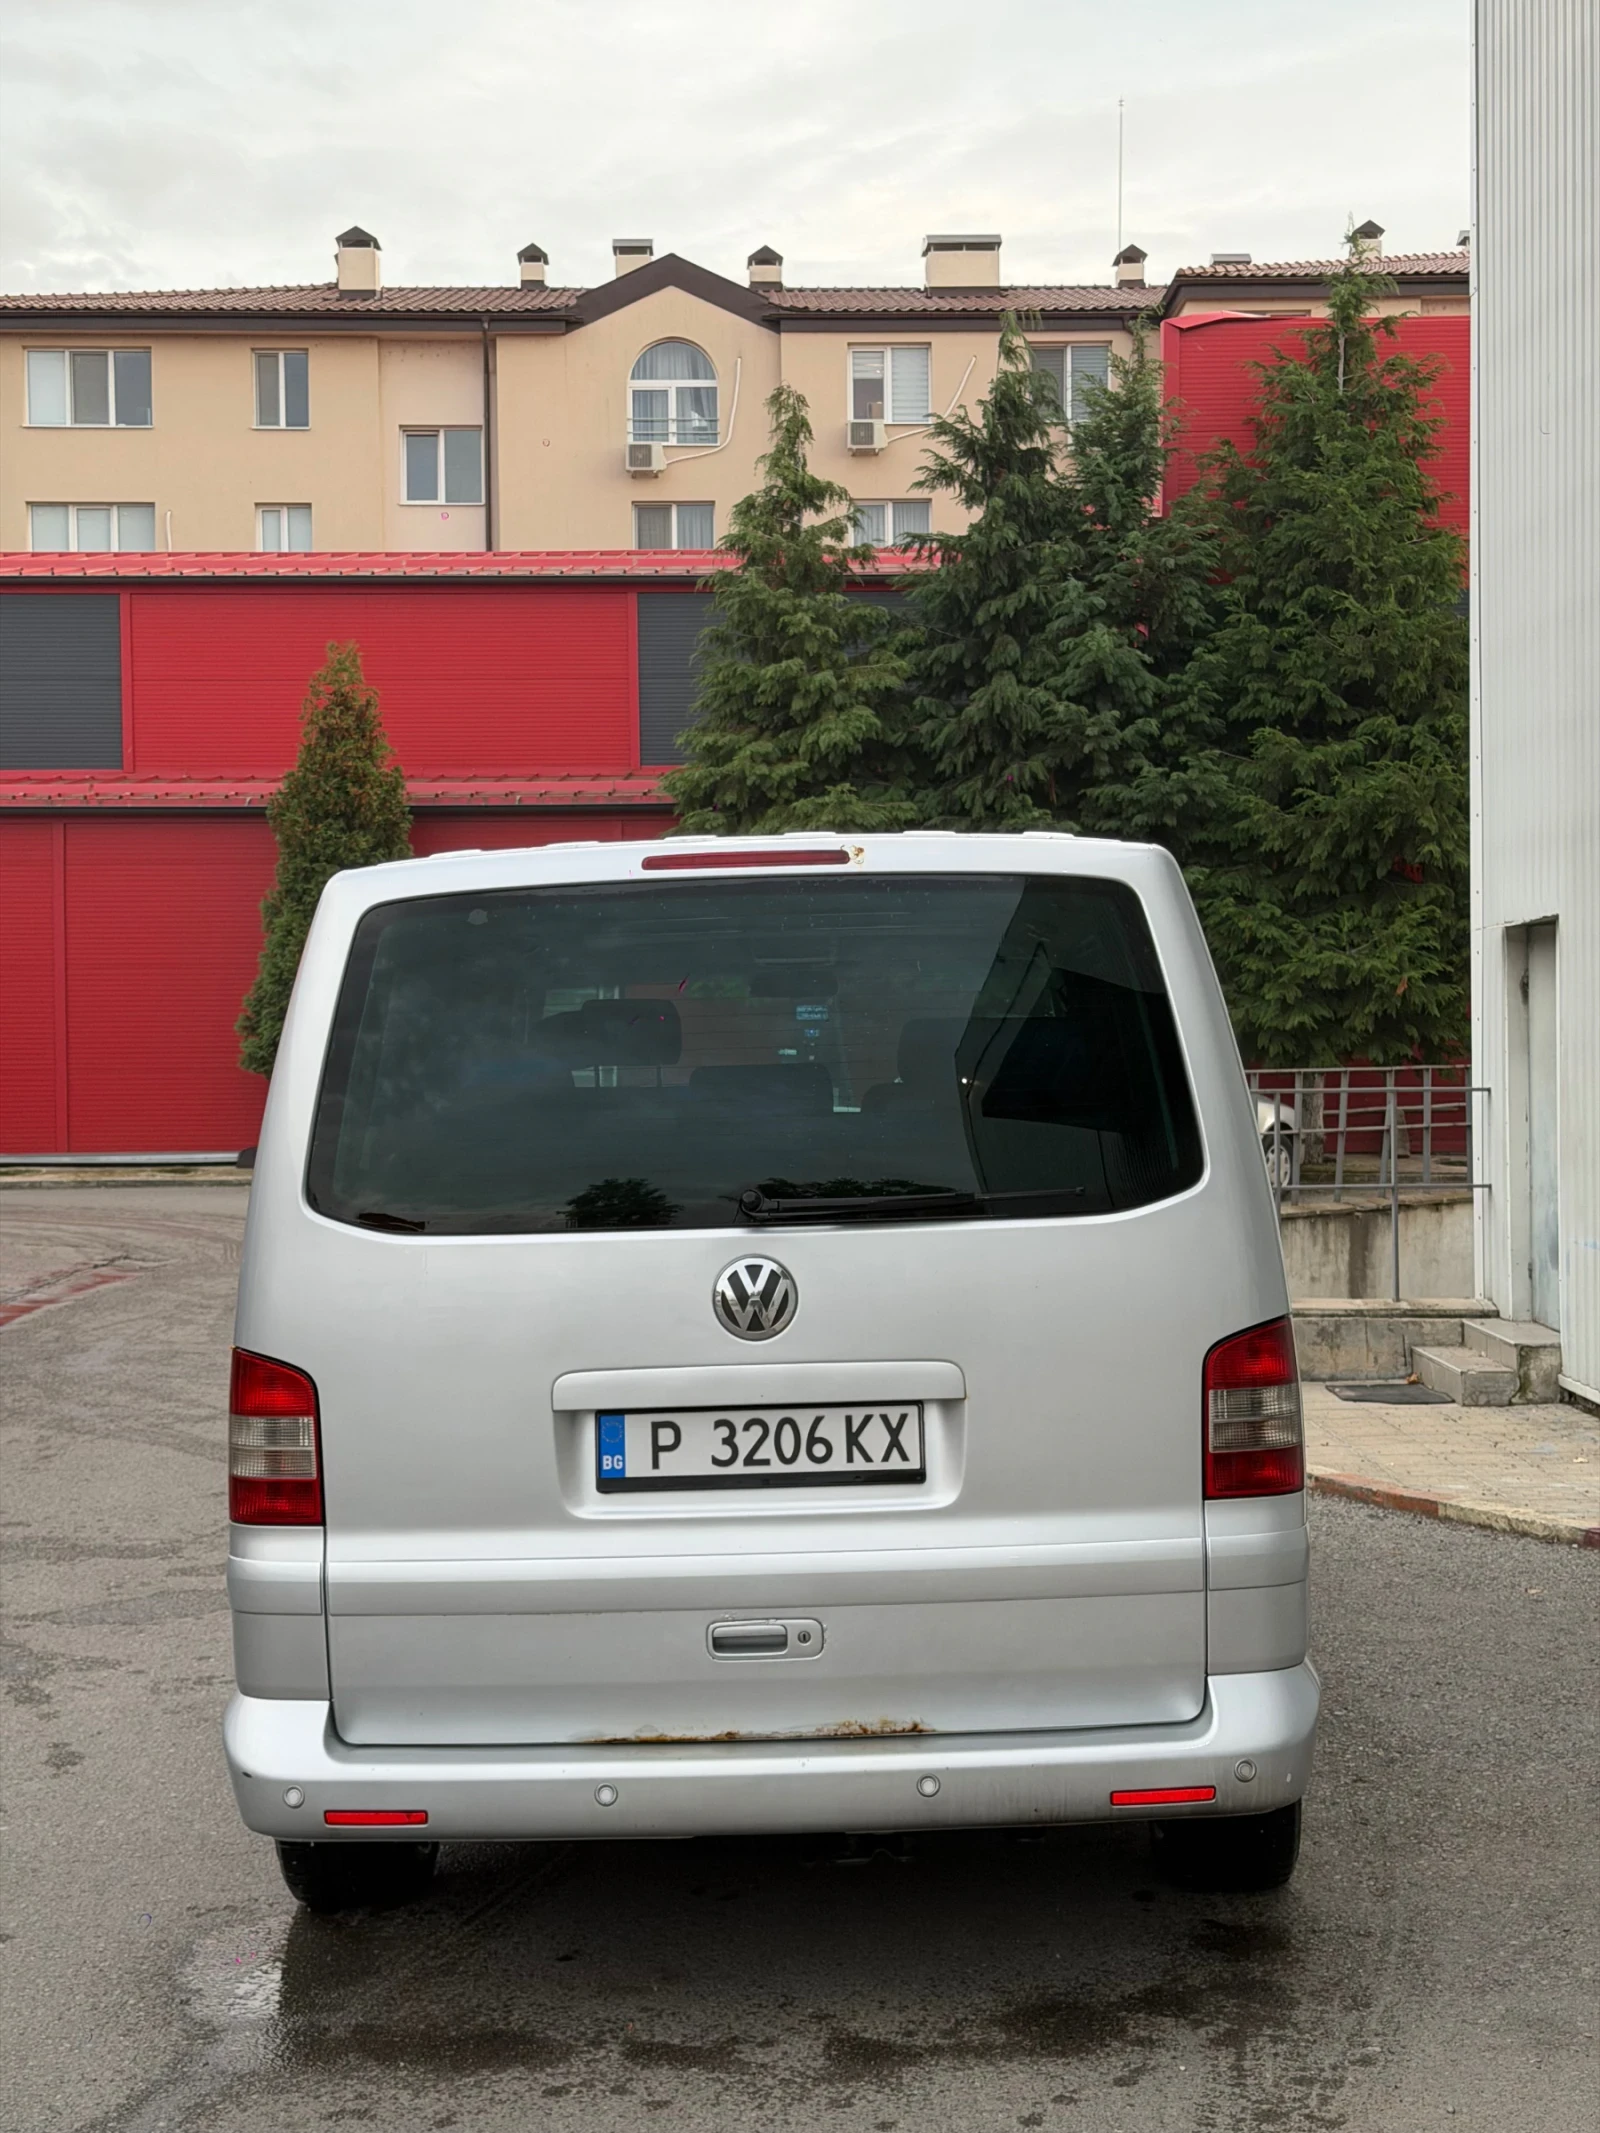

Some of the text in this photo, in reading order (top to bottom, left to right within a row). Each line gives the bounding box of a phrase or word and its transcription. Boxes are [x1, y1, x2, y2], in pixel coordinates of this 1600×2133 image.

[716, 1258, 794, 1337] VW
[602, 1454, 624, 1471] BG
[650, 1420, 682, 1471] P
